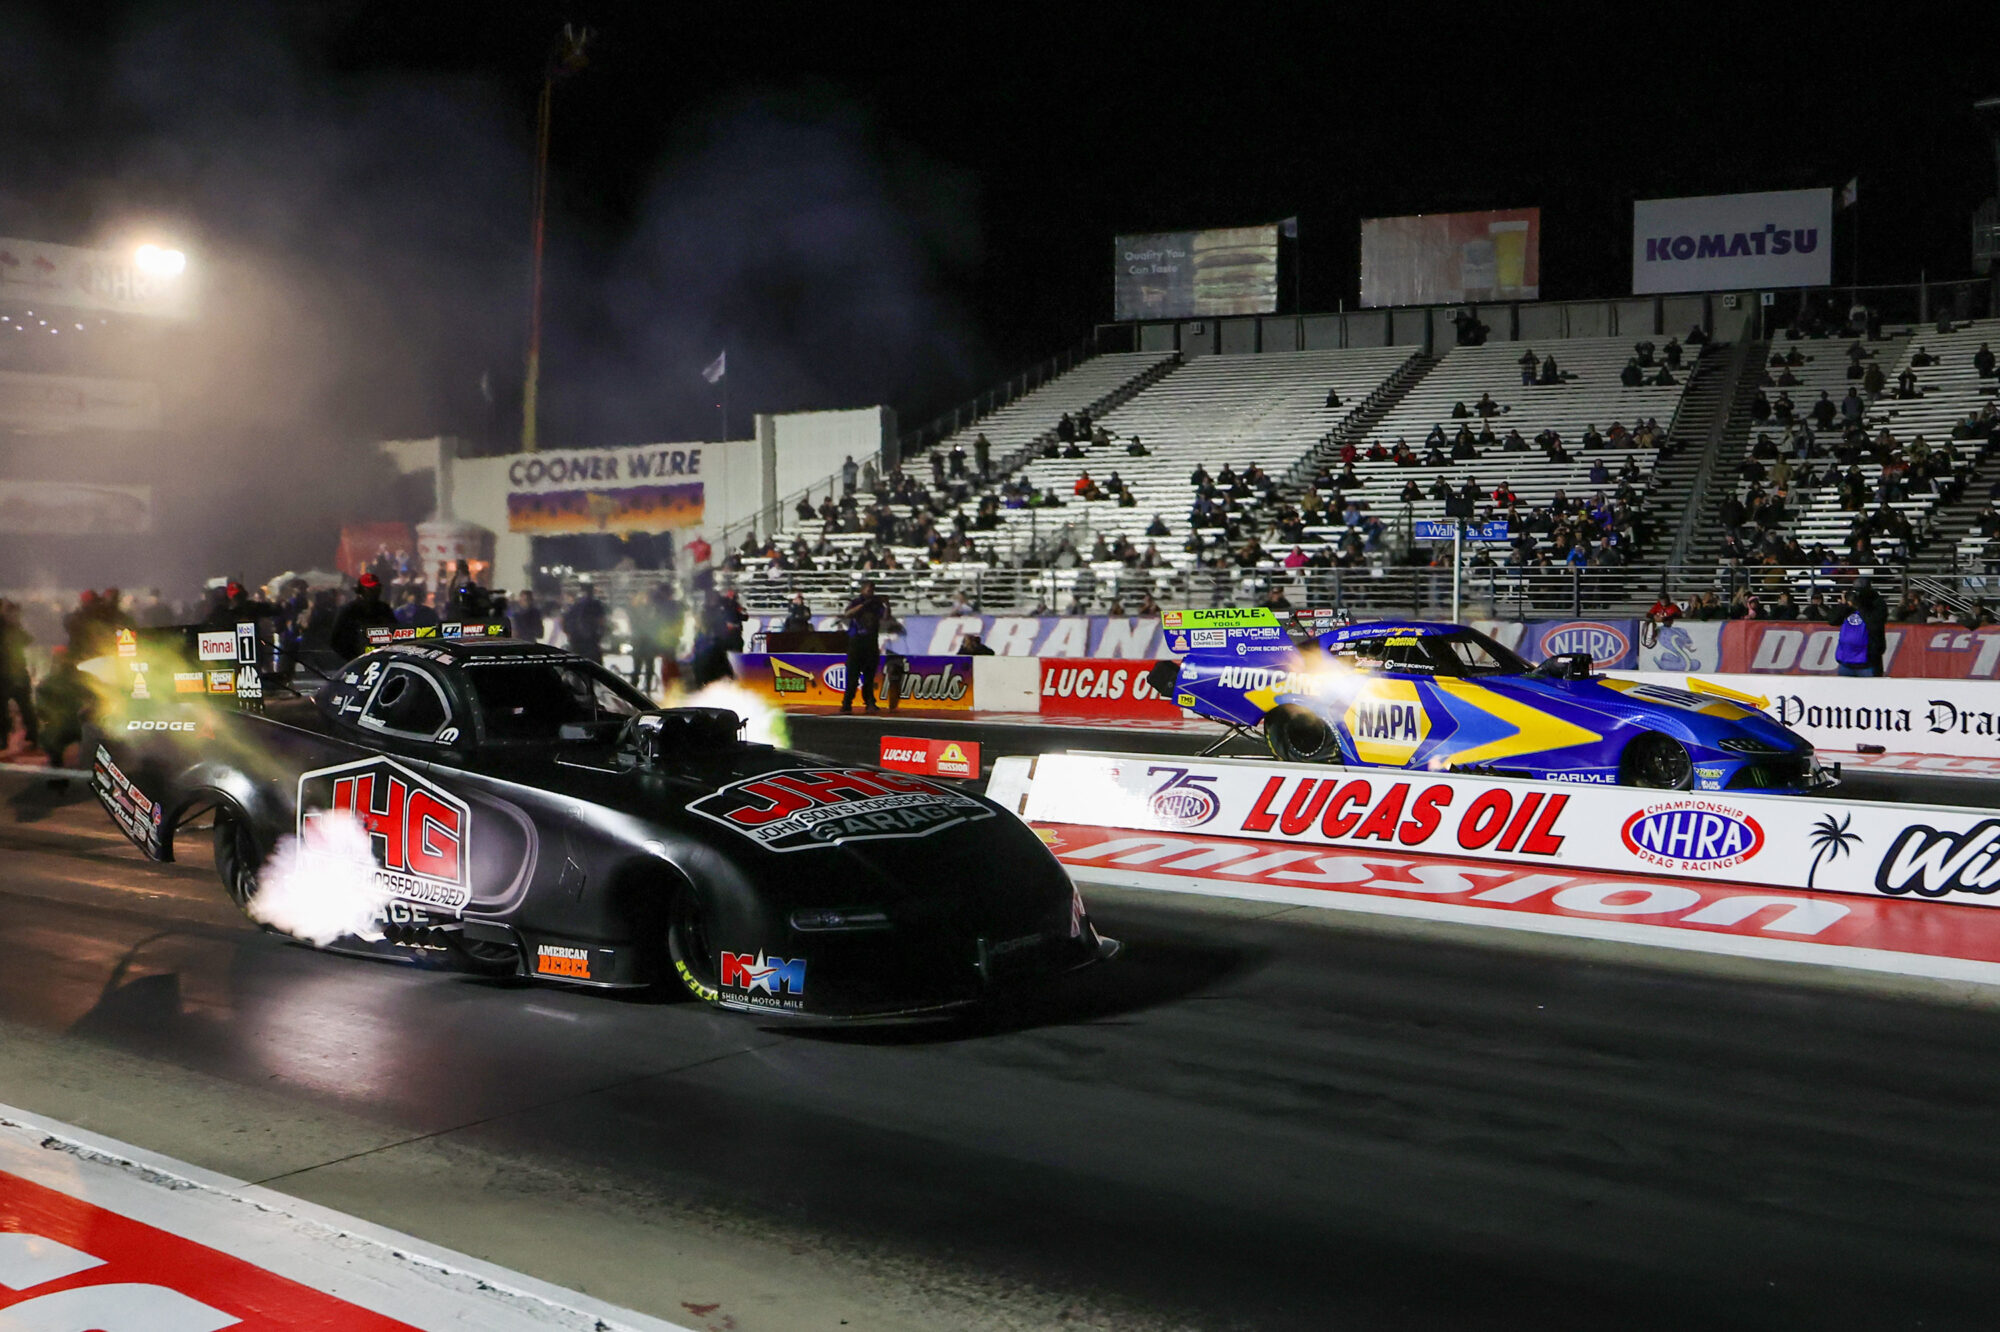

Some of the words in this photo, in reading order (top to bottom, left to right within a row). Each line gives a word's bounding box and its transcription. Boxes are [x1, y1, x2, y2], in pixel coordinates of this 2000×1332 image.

[1646, 224, 1818, 262] KOMATSU
[1124, 250, 1163, 262] Quality
[1166, 249, 1187, 259] You
[1128, 265, 1149, 275] Can
[1152, 263, 1179, 275] Taste
[508, 455, 619, 486] COONER
[627, 449, 702, 478] WIRE
[1193, 609, 1260, 620] CARLYLE
[393, 629, 415, 639] ARP
[1192, 631, 1213, 641] USA
[1227, 628, 1280, 638] REVCHEM
[1554, 630, 1617, 659] NHRA
[202, 638, 234, 654] Rinnai
[241, 637, 250, 660] 1
[1751, 629, 1901, 674] DO
[236, 665, 262, 689] MAC
[1042, 667, 1132, 699] LUCAS
[1217, 665, 1268, 691] AUTO
[236, 689, 262, 698] TOOLS
[126, 720, 197, 731] DODGE
[1358, 701, 1418, 742] NAPA
[1776, 694, 1912, 732] Pomona
[1925, 699, 2000, 741] Dra
[882, 748, 911, 762] LUCAS
[912, 751, 927, 763] OIL
[1545, 772, 1616, 784] CARLYLE
[723, 770, 947, 826] JHG
[1147, 766, 1221, 829] 75
[1157, 795, 1206, 819] NHRA
[1647, 800, 1744, 819] CHAMPIONSHIP
[302, 771, 461, 884] JHG
[756, 803, 860, 841] JOHNSON'S
[811, 803, 957, 840] GARAG
[1240, 776, 1455, 846] LUCAS
[1457, 788, 1571, 856] OIL
[1640, 812, 1743, 859] NHRA
[1638, 850, 1674, 869] DRAG
[1681, 857, 1733, 871] RACING
[368, 872, 466, 907] HORSEPOWERED
[536, 943, 589, 961] AMERICAN
[537, 954, 592, 980] REBEL
[721, 991, 749, 1002] SHELOR
[751, 996, 781, 1007] MOTOR
[783, 999, 804, 1009] MILE
